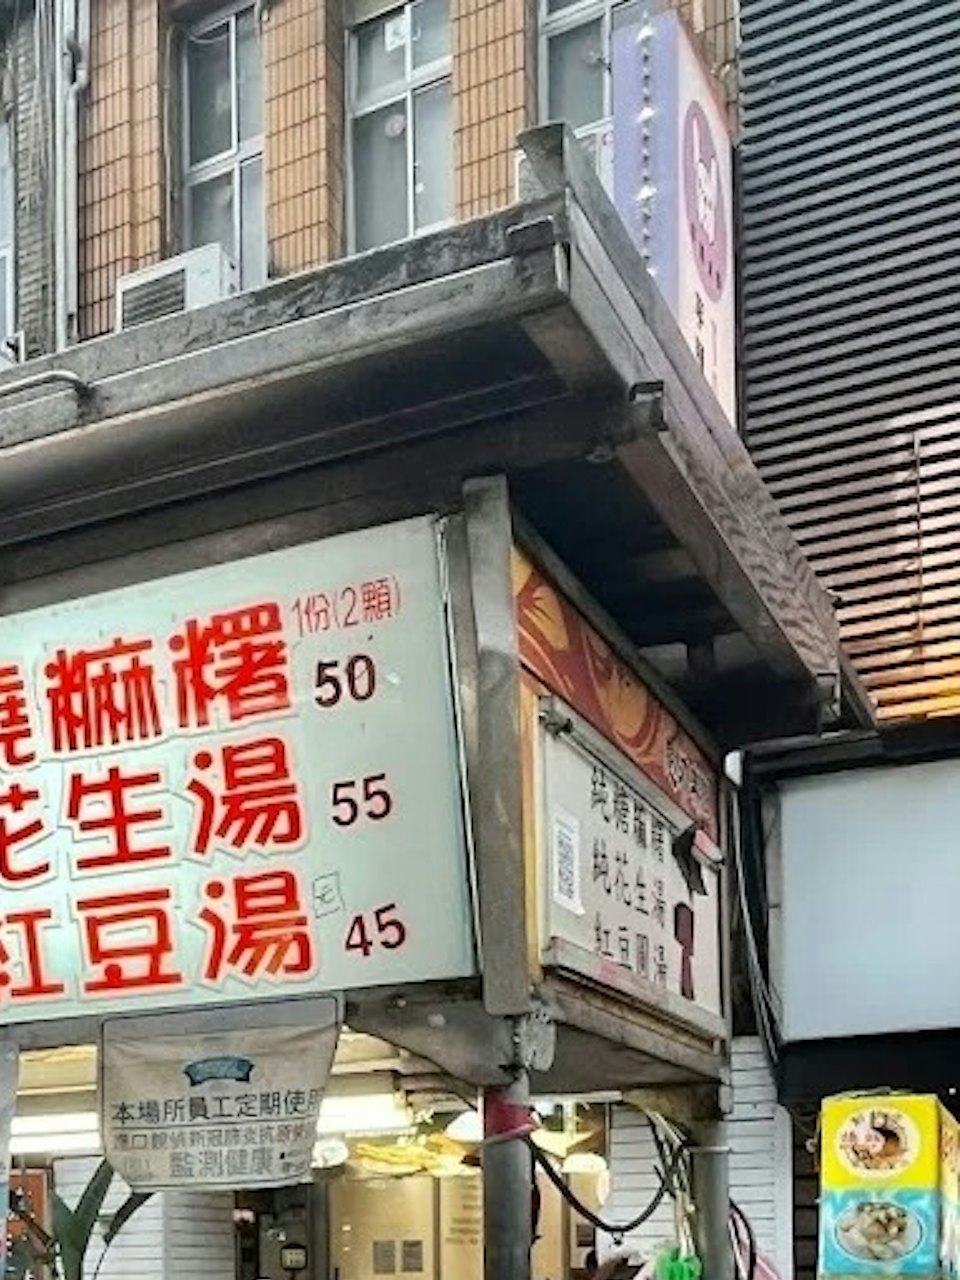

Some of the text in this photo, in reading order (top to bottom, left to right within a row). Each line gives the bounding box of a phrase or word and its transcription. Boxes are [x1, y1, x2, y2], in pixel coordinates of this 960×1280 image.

[315, 654, 376, 708] 50
[332, 773, 393, 826] 55
[345, 903, 406, 957] 45
